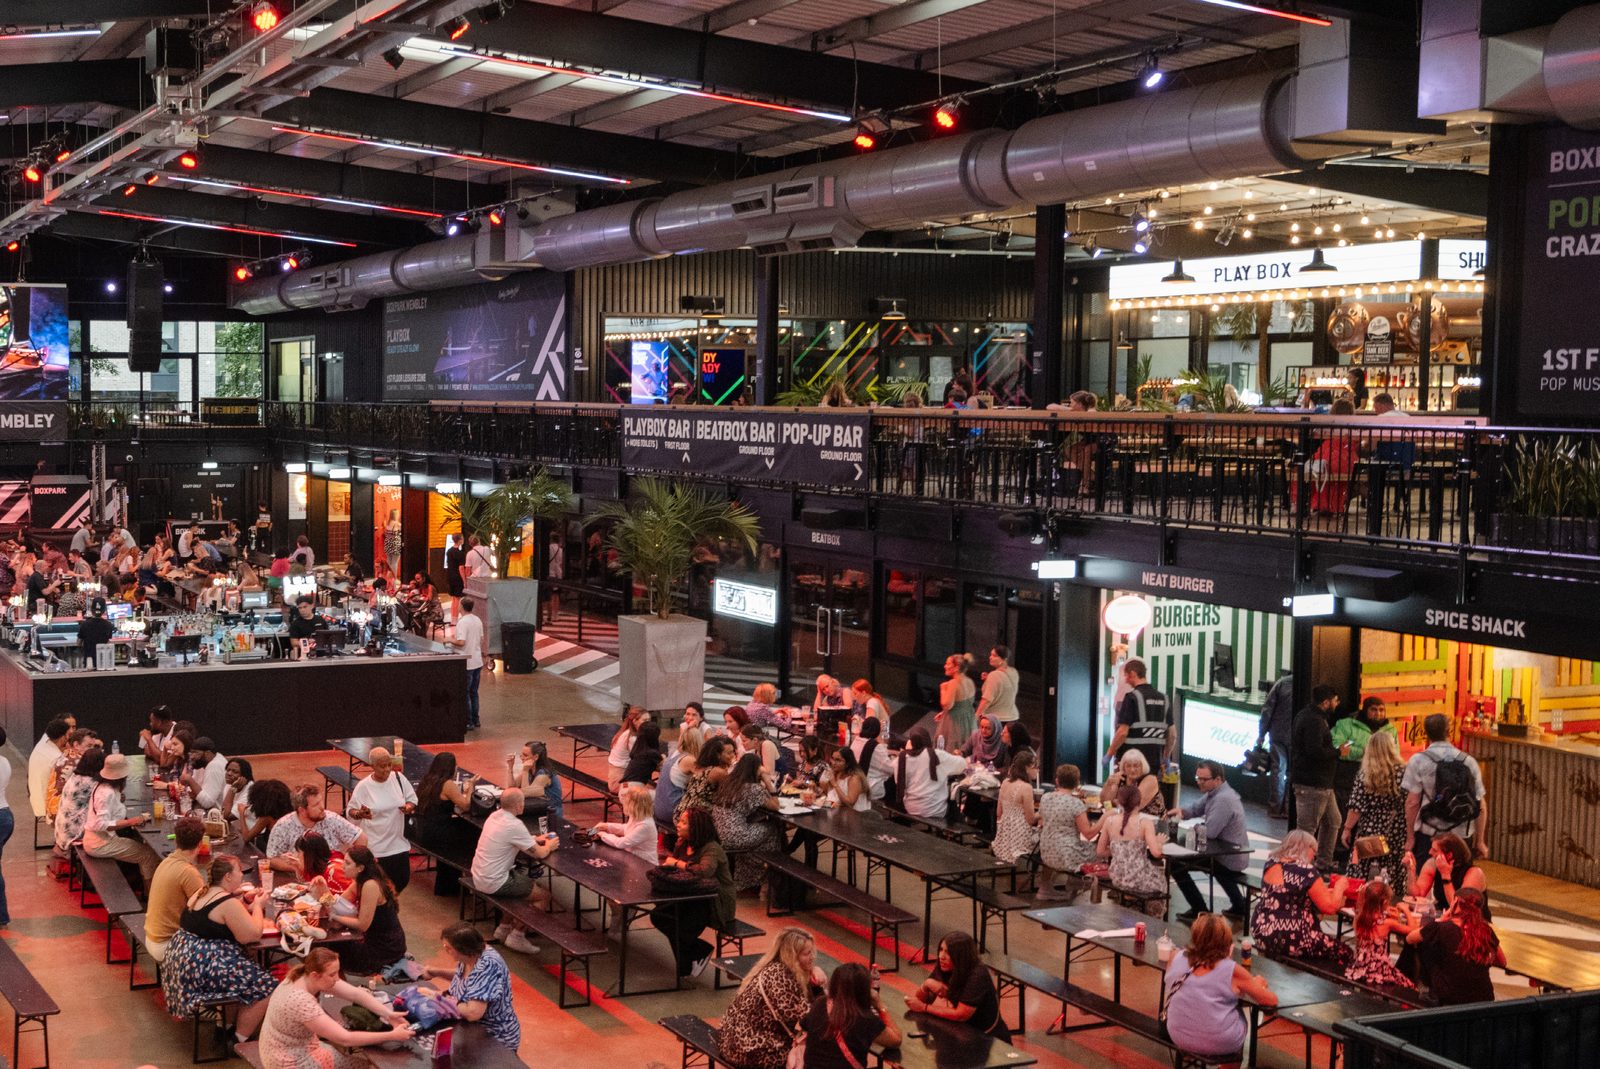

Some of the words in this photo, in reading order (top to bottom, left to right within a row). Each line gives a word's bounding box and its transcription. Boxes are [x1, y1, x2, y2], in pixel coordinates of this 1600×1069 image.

[1546, 233, 1600, 258] CRAZ
[1214, 265, 1251, 283] PLAY
[1257, 261, 1292, 281] BOX
[386, 328, 410, 343] PLAYBOX
[1542, 348, 1581, 370] 1ST
[1586, 348, 1599, 370] F
[1541, 377, 1567, 391] POP
[1574, 377, 1600, 391] MUS
[0, 413, 54, 428] MBLEY
[624, 417, 667, 437] PLAYBOX
[668, 419, 690, 439] BAR
[696, 420, 748, 442] BEATBOX
[750, 421, 775, 443] BAR
[783, 423, 831, 446] POP-UP
[833, 425, 863, 448] BAR
[665, 441, 676, 450] FIRST
[676, 442, 690, 450] FLOOR
[739, 445, 758, 455] GROUND
[759, 446, 775, 456] FLOOR
[820, 450, 843, 461] GROUND
[843, 451, 862, 462] FLOOR
[811, 531, 840, 546] BEATBOX
[1142, 571, 1168, 587] NEAT
[1169, 574, 1214, 594] BURGER
[1153, 603, 1221, 628] BURGERS
[1425, 608, 1469, 630] SPICE
[1471, 614, 1526, 638] SHACK
[1152, 633, 1161, 648] IN
[1165, 632, 1192, 647] TOWN
[1210, 725, 1250, 748] neat
